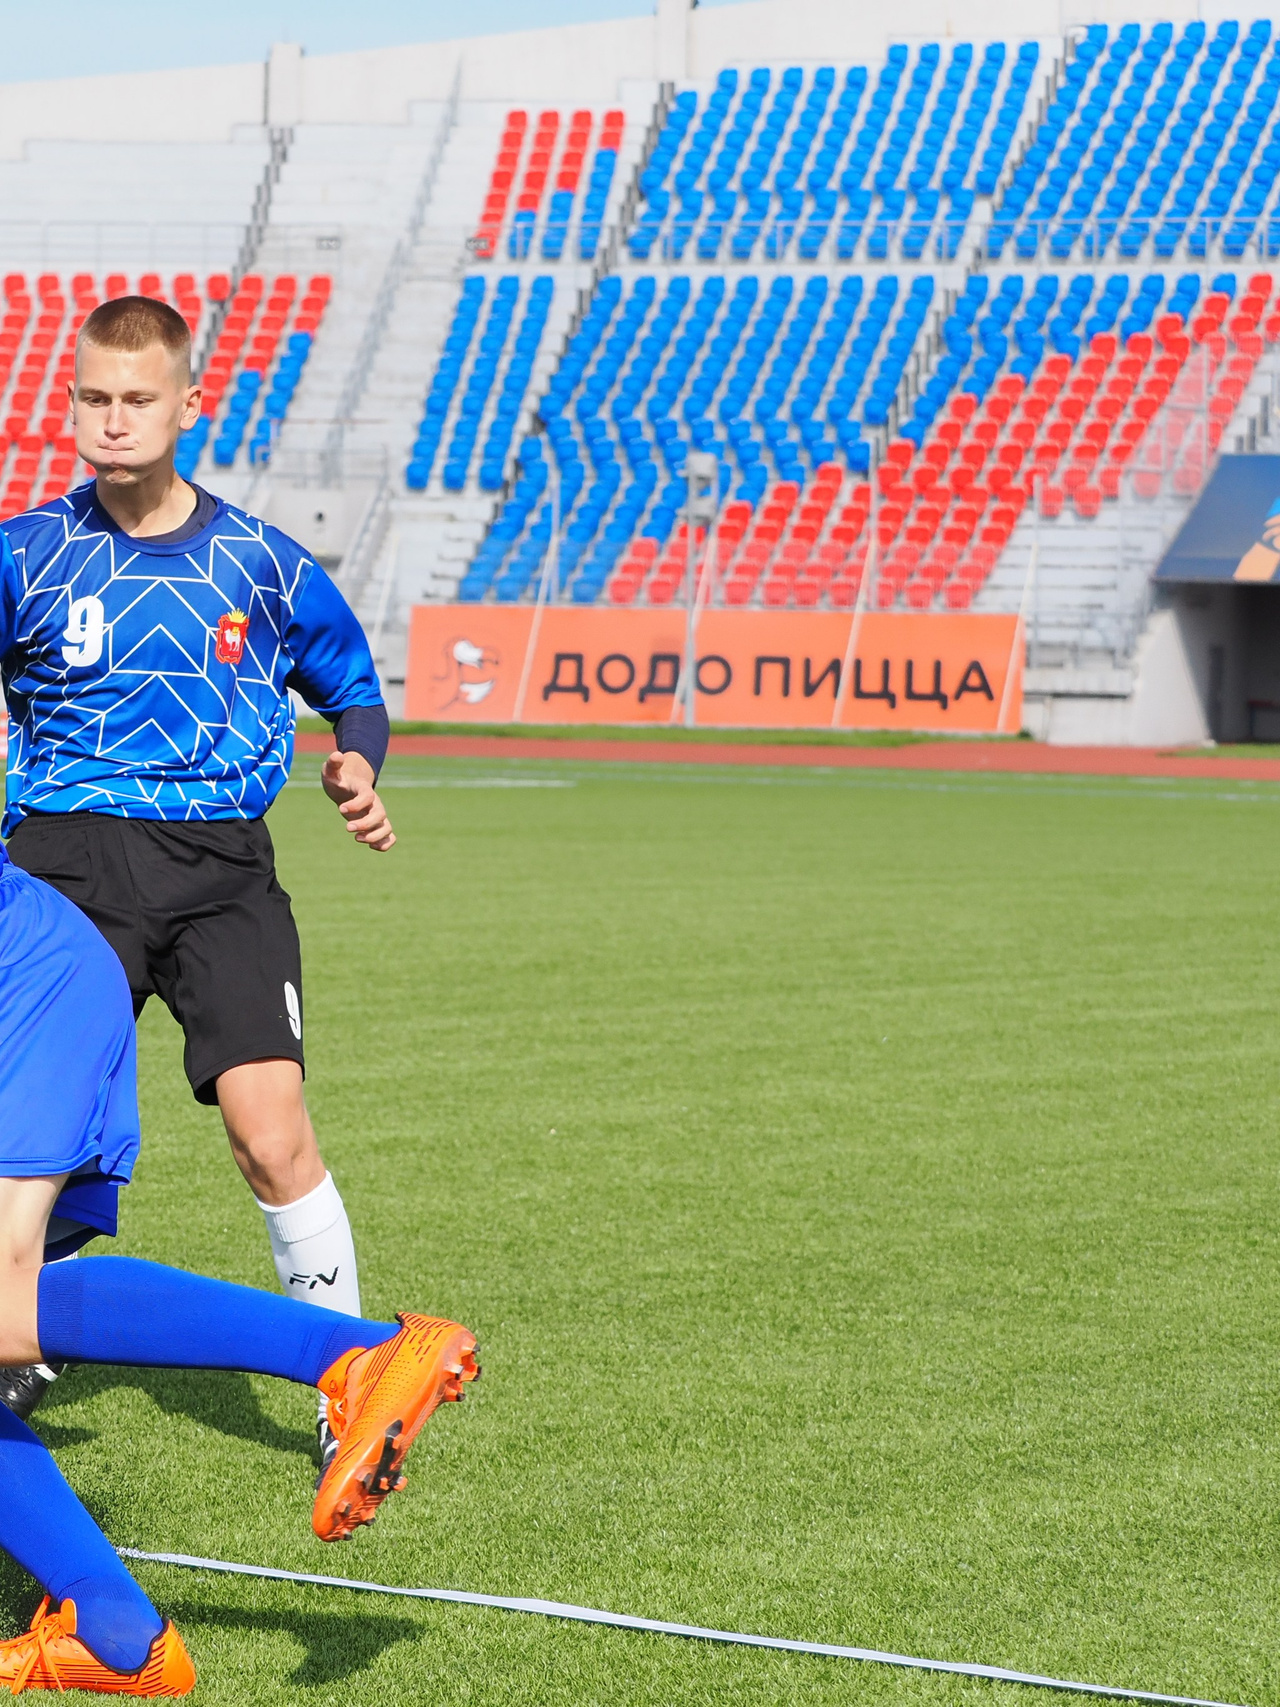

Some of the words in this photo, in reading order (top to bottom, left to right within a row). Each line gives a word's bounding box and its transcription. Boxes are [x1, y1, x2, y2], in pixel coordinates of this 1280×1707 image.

[62, 596, 106, 667] 9
[543, 652, 732, 704] ДОДО
[754, 656, 995, 711] ПИЦЦА
[284, 980, 302, 1040] 9
